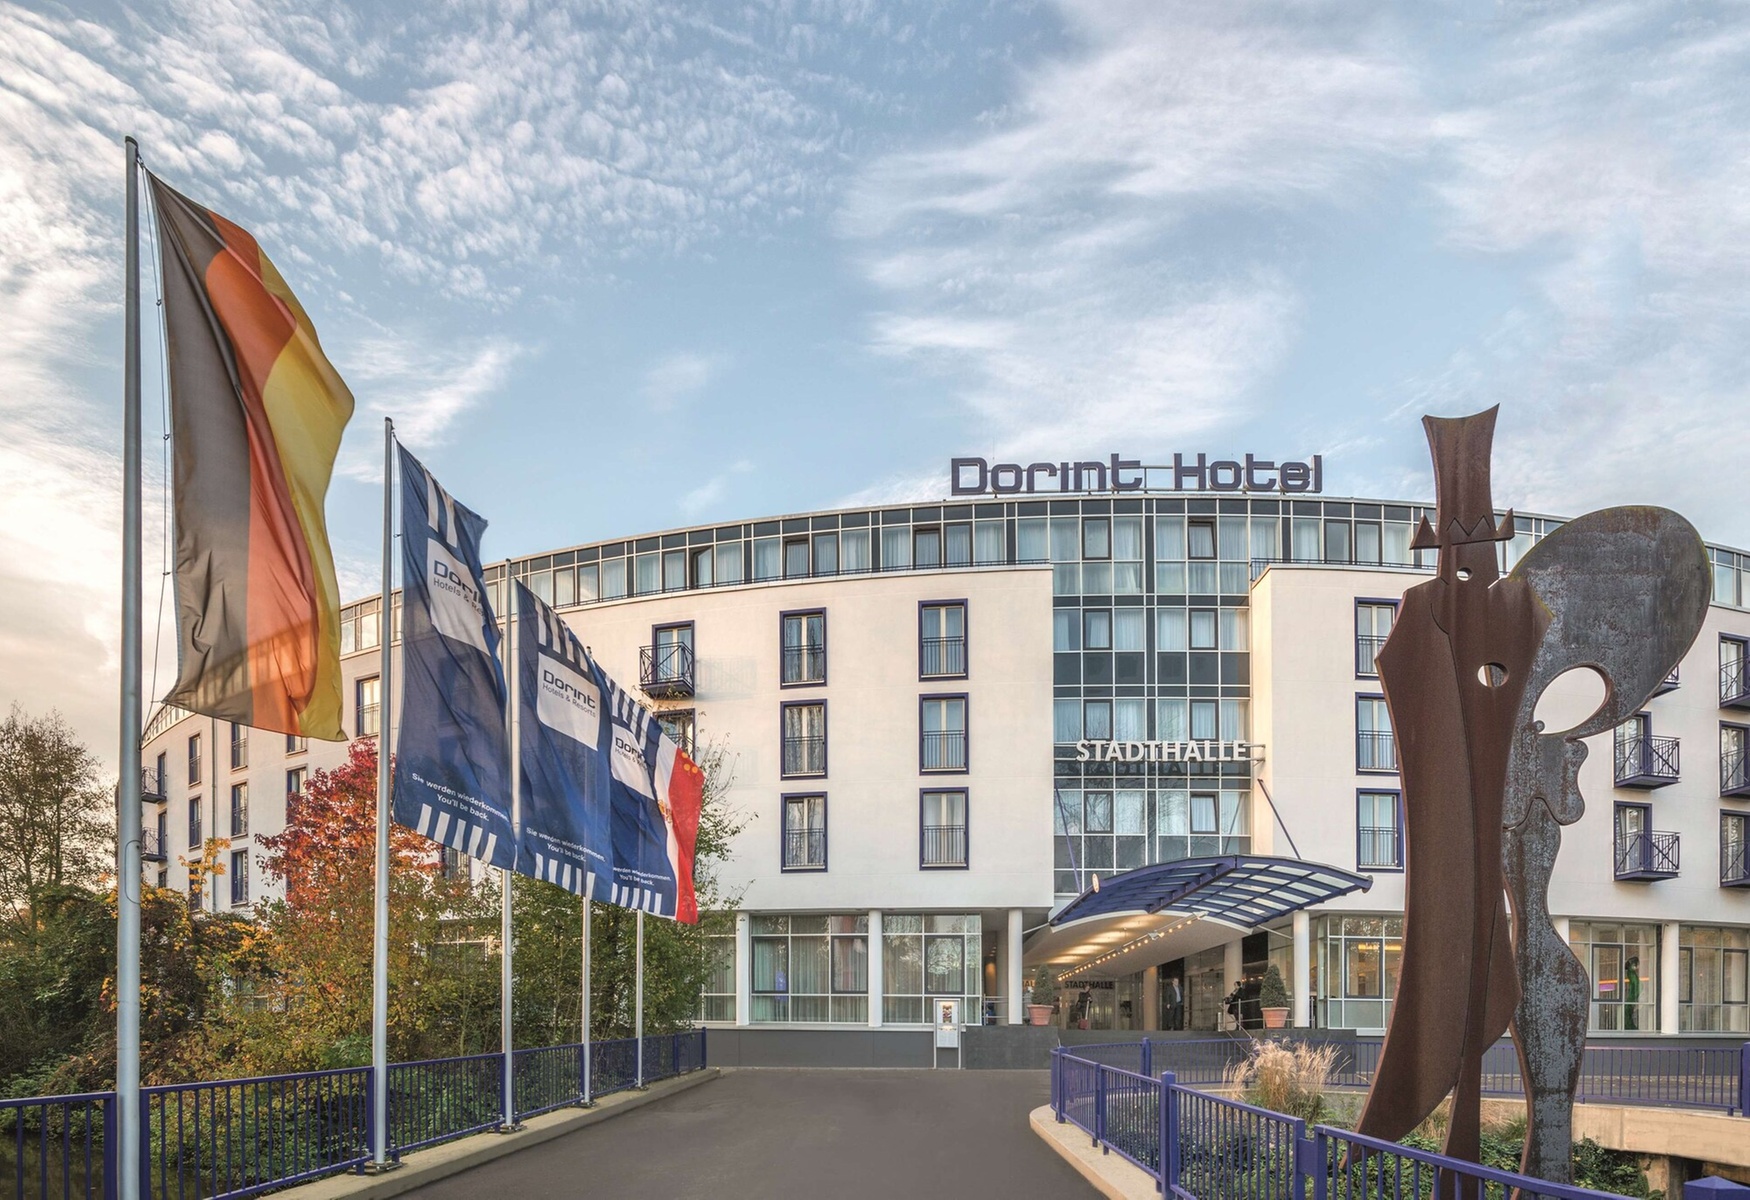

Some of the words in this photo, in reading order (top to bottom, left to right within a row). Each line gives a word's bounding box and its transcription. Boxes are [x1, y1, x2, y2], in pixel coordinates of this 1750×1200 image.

[951, 453, 1142, 496] Dorint
[1173, 453, 1322, 493] Hotel
[433, 577, 461, 597] Hotels
[543, 669, 596, 709] Dorint
[1076, 739, 1247, 762] STADTHALLE
[412, 772, 425, 784] Sie
[426, 780, 457, 796] werden
[437, 793, 459, 808] You'll
[459, 802, 469, 812] be
[469, 807, 490, 822] back.
[526, 826, 538, 837] Sie
